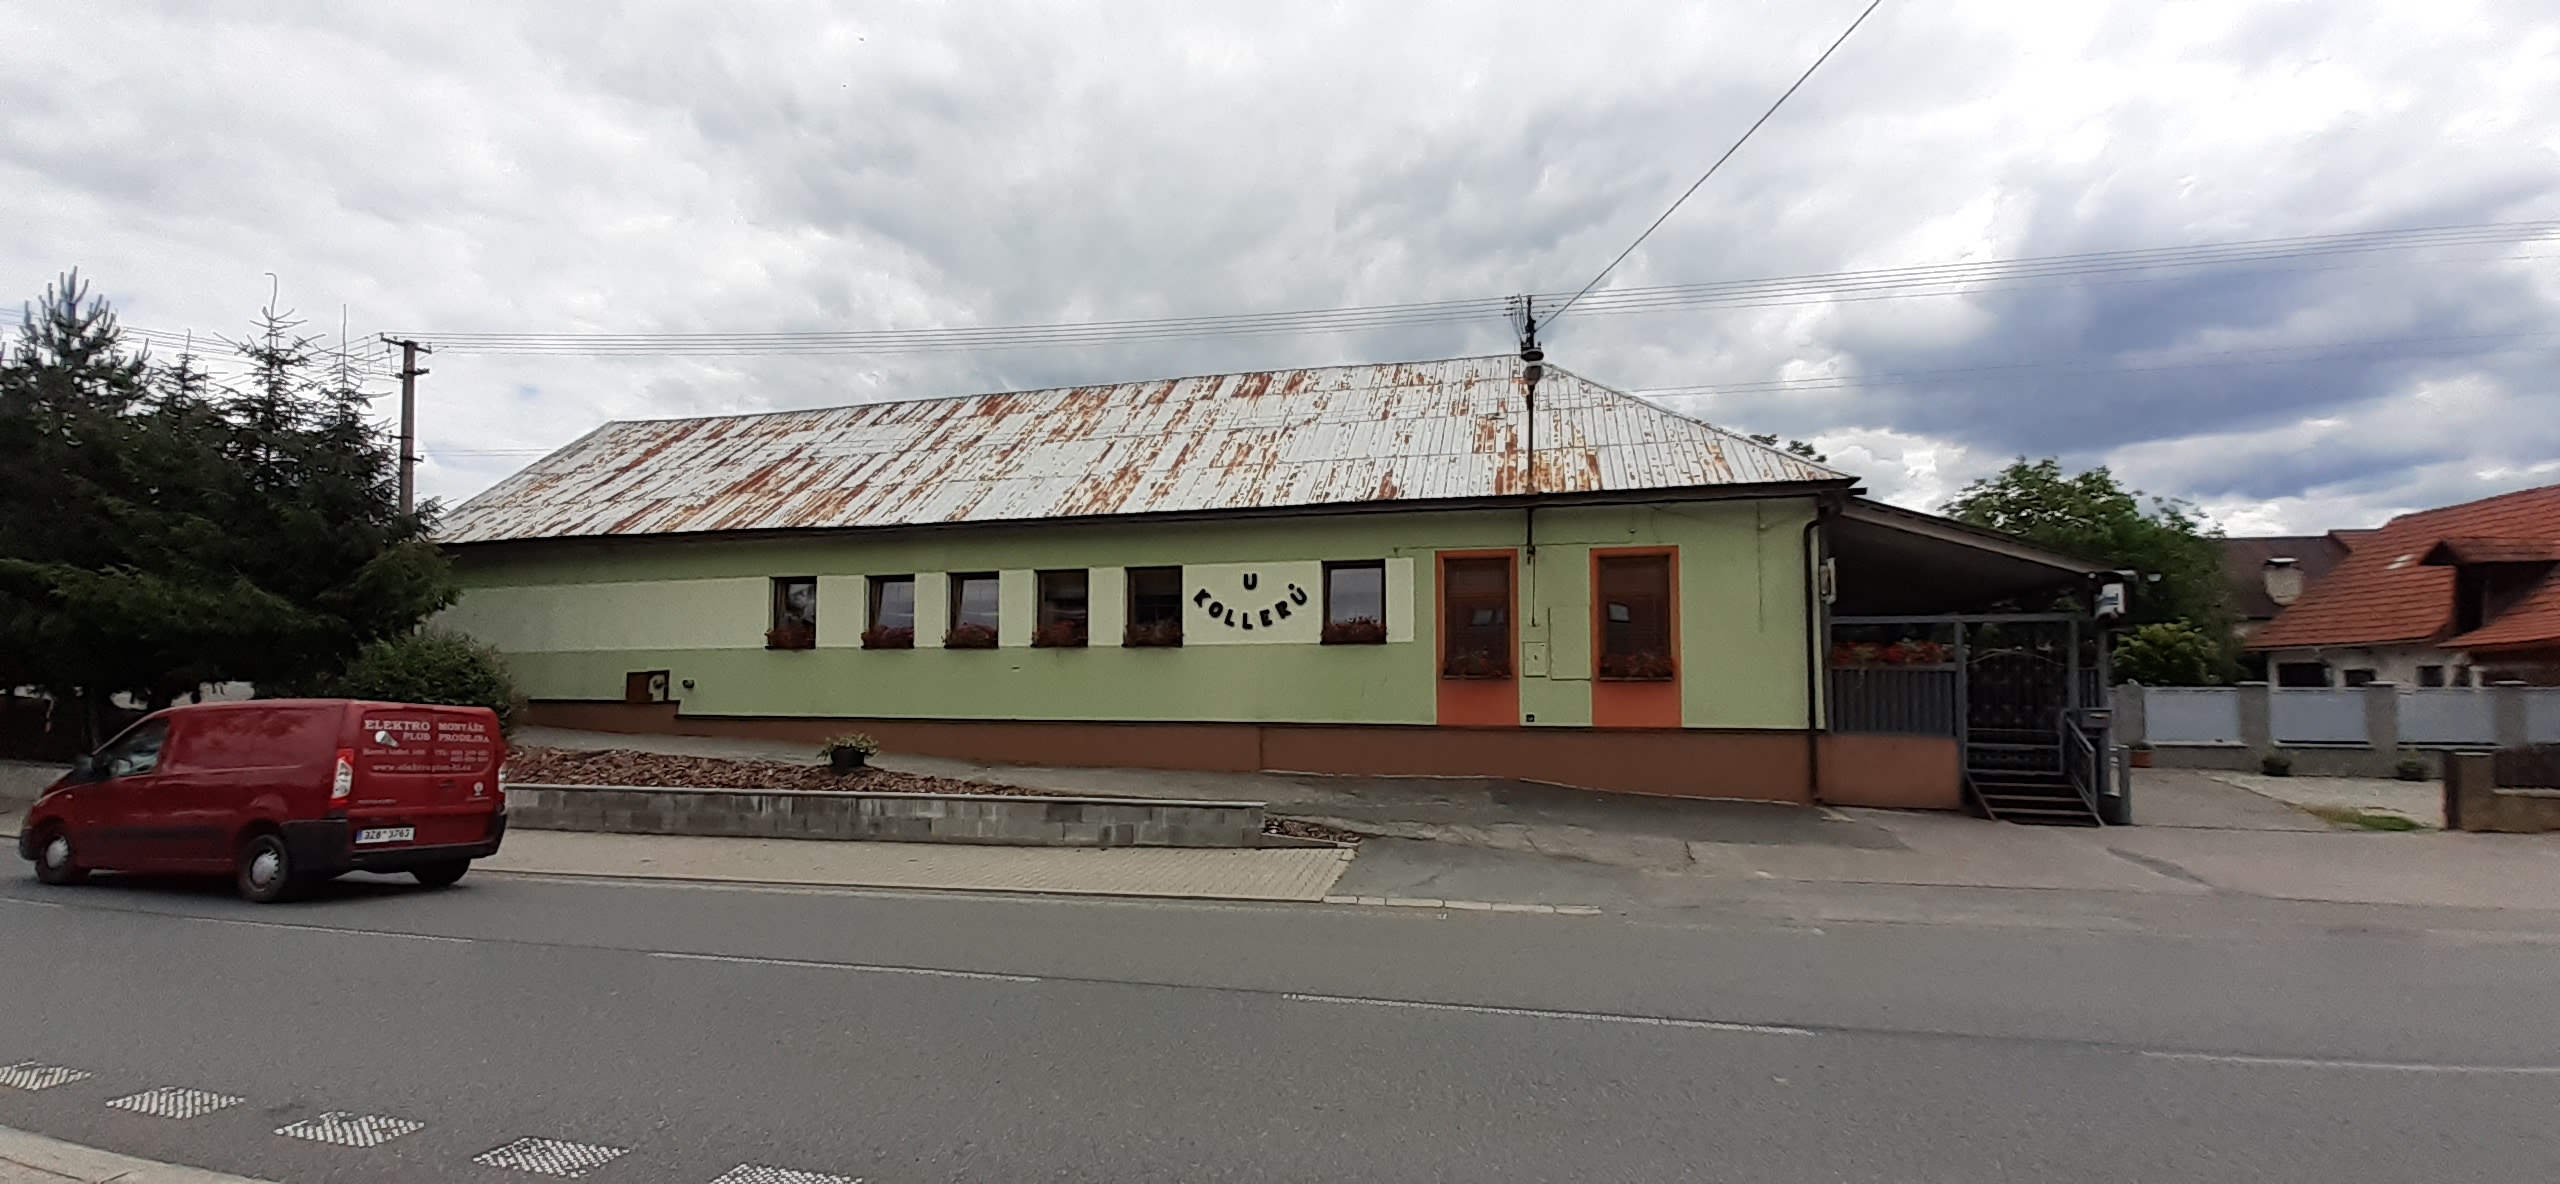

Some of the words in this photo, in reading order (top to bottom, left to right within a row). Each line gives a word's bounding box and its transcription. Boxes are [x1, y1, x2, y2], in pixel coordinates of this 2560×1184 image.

[1243, 573, 1258, 590] U
[1193, 583, 1308, 630] KOLLERŮ
[364, 719, 431, 731] ELEKTRO
[402, 732, 431, 741] PLUS
[438, 733, 490, 743] PRODEJNA
